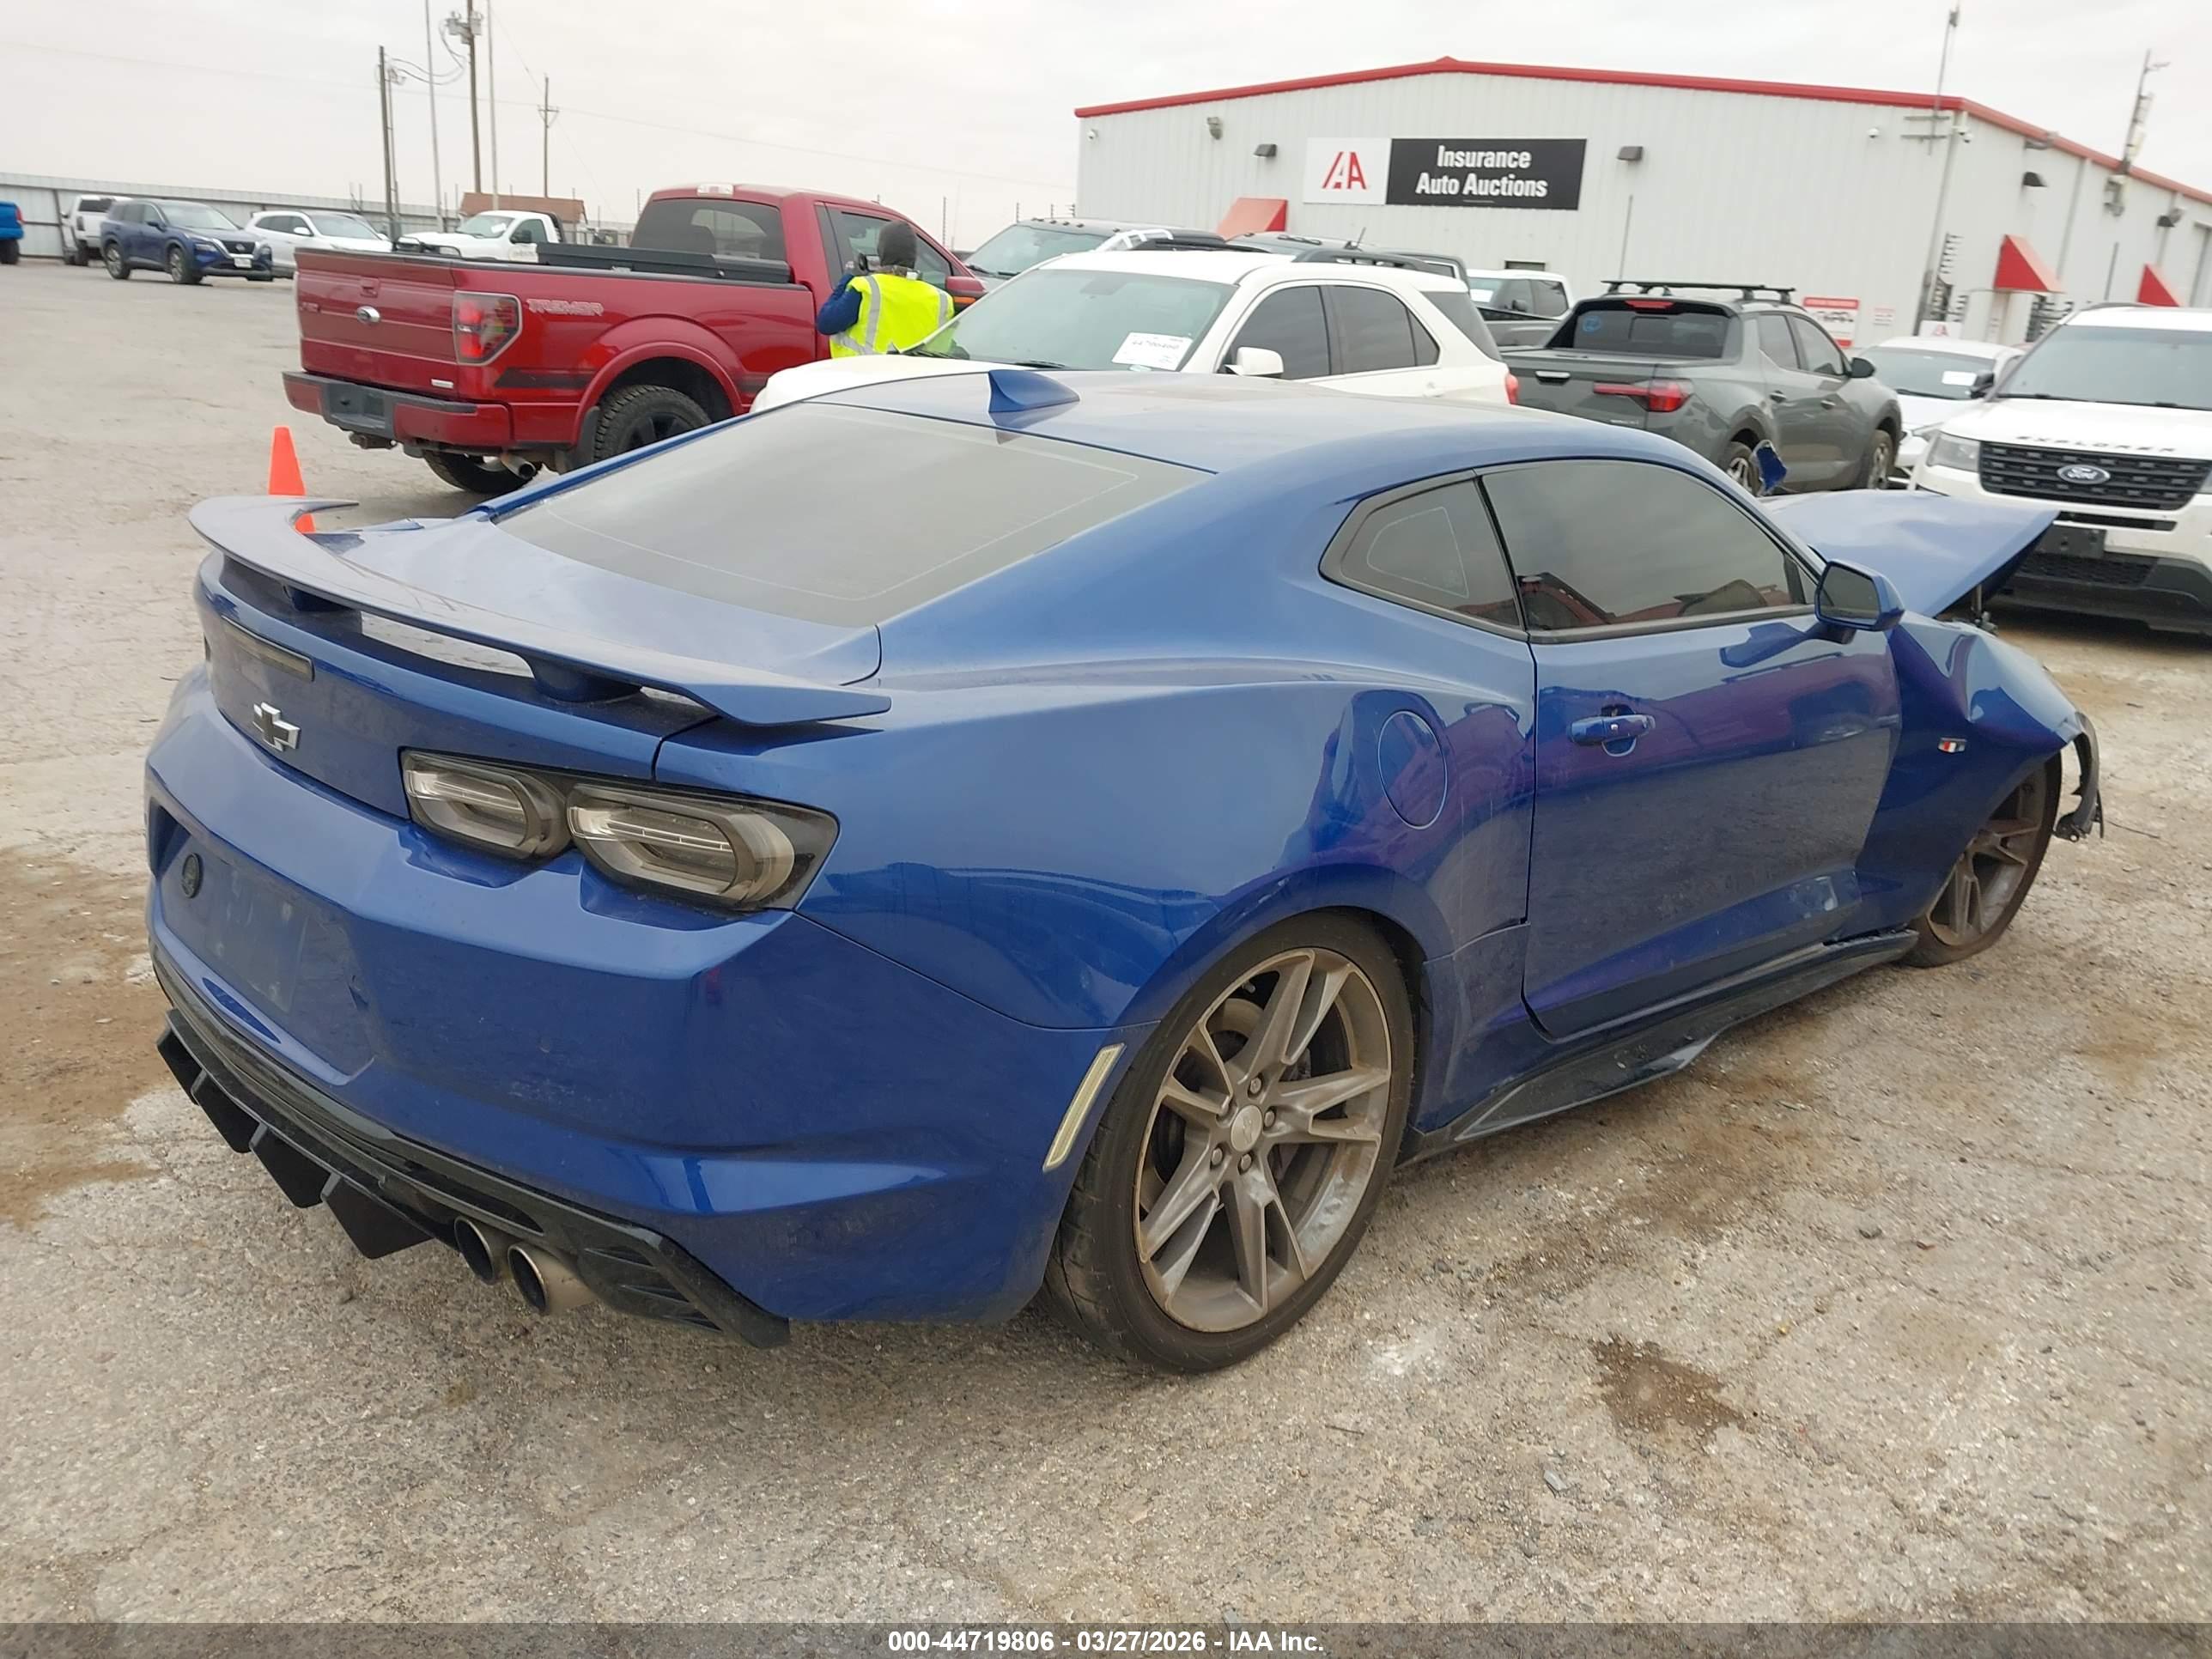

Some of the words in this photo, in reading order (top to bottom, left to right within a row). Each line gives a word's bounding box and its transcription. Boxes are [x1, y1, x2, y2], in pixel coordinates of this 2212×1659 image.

[1437, 144, 1532, 168] Insurance
[1415, 172, 1460, 195] Auto
[1462, 173, 1548, 198] Auctions
[526, 298, 605, 317] TREMOR
[2016, 435, 2176, 453] EXPLORER
